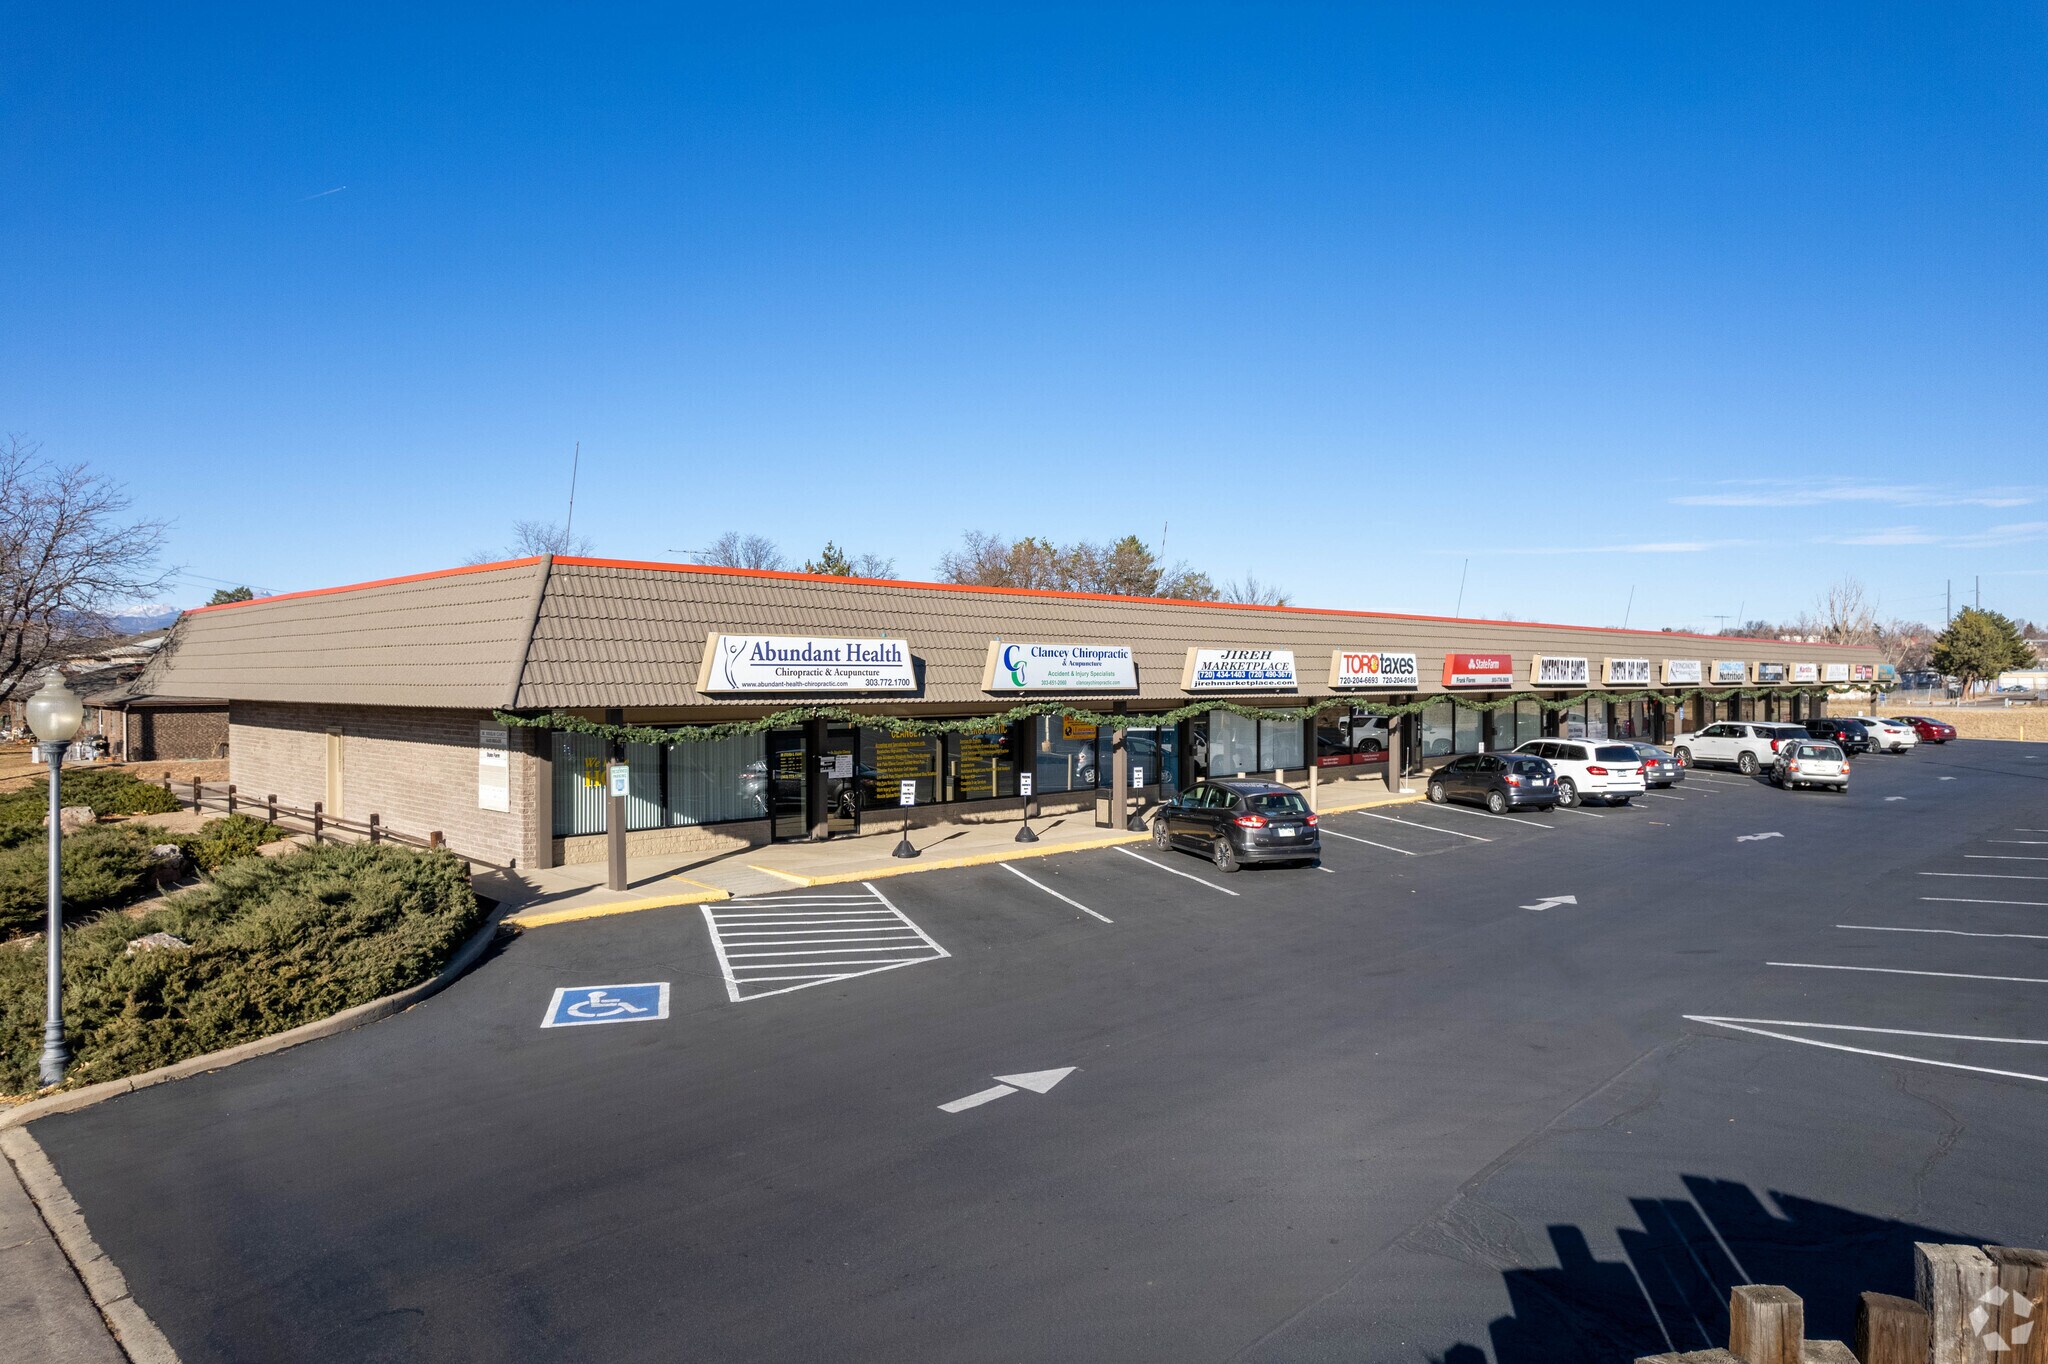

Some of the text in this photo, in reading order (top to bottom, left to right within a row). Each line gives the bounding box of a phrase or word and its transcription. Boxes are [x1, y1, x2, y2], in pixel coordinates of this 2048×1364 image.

[749, 641, 902, 662] Abundant Health
[1031, 646, 1128, 661] Clancey Chiropractic
[1220, 650, 1272, 660] JIREH
[1201, 661, 1289, 671] MARKETPLACE
[775, 667, 880, 678] Chiropractic & Acupuncture
[1719, 671, 1744, 681] Nutrition
[742, 680, 848, 688] www.abundant-health-chiropractic.com
[865, 678, 910, 687] 303.772.1700
